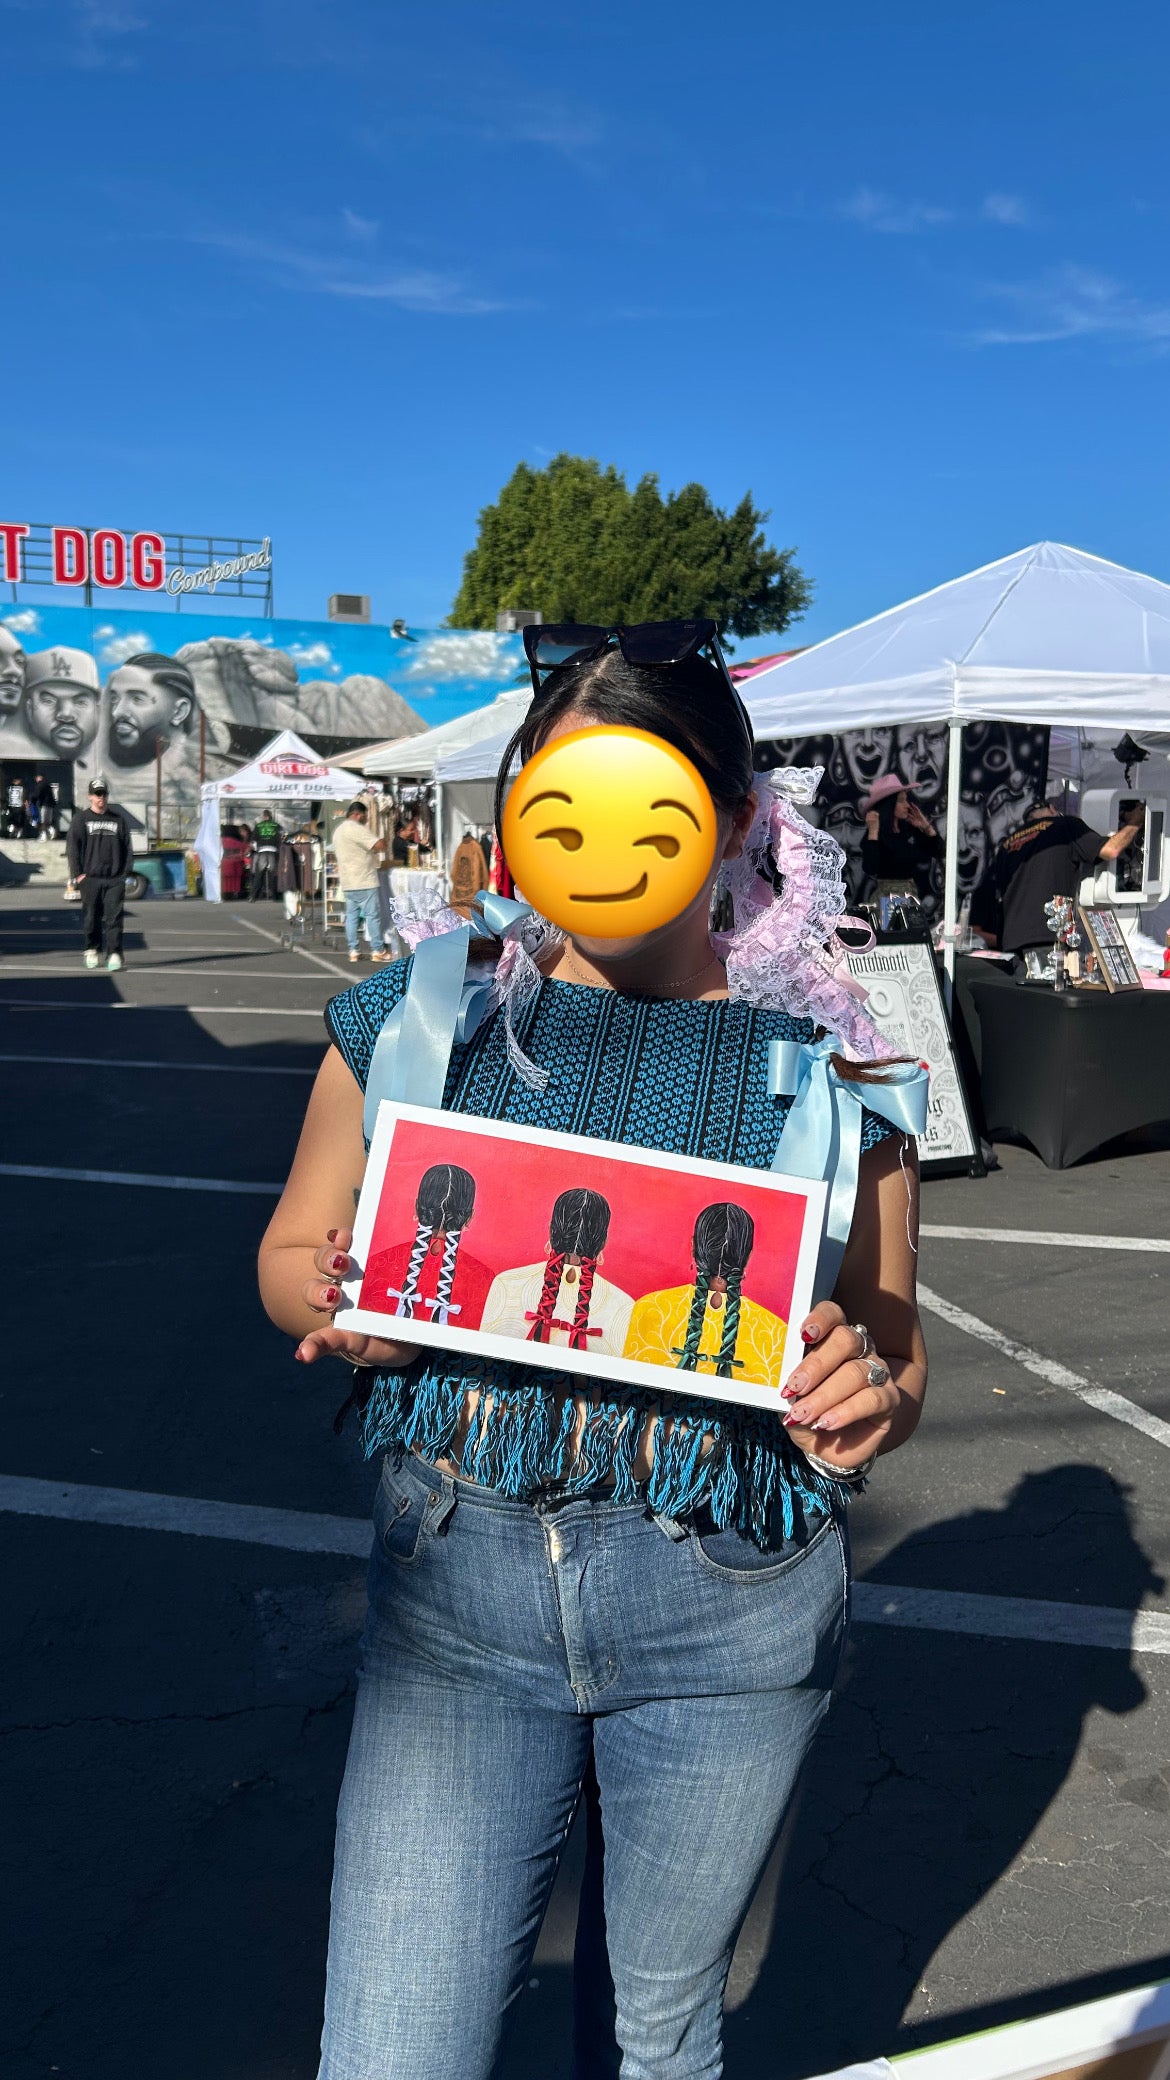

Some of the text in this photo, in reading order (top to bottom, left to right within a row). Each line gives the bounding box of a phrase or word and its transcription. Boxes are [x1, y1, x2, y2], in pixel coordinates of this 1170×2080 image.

[52, 526, 165, 591] DOG
[165, 536, 272, 596] Compound
[263, 763, 293, 775] DIRT
[843, 950, 911, 975] hotobooth
